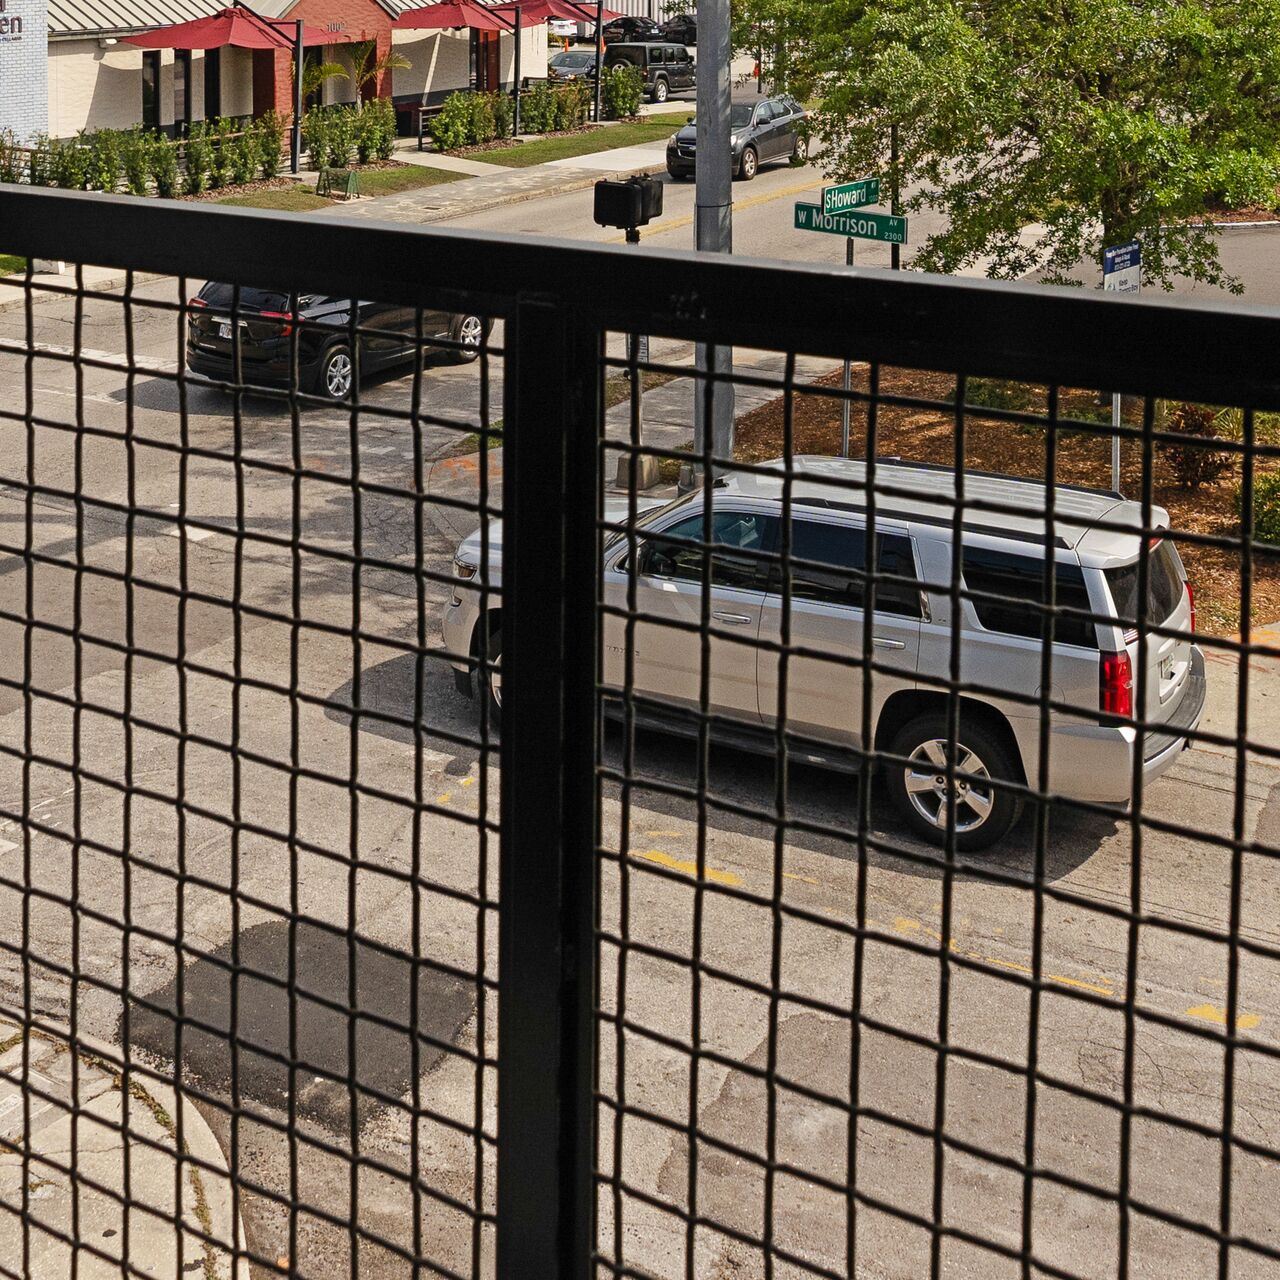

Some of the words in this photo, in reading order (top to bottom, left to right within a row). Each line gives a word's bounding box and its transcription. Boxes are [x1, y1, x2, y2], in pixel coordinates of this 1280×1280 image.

[831, 183, 867, 209] Howard
[797, 209, 807, 224] W
[812, 208, 877, 236] Morrison
[889, 218, 898, 227] AV
[883, 231, 903, 241] 2300
